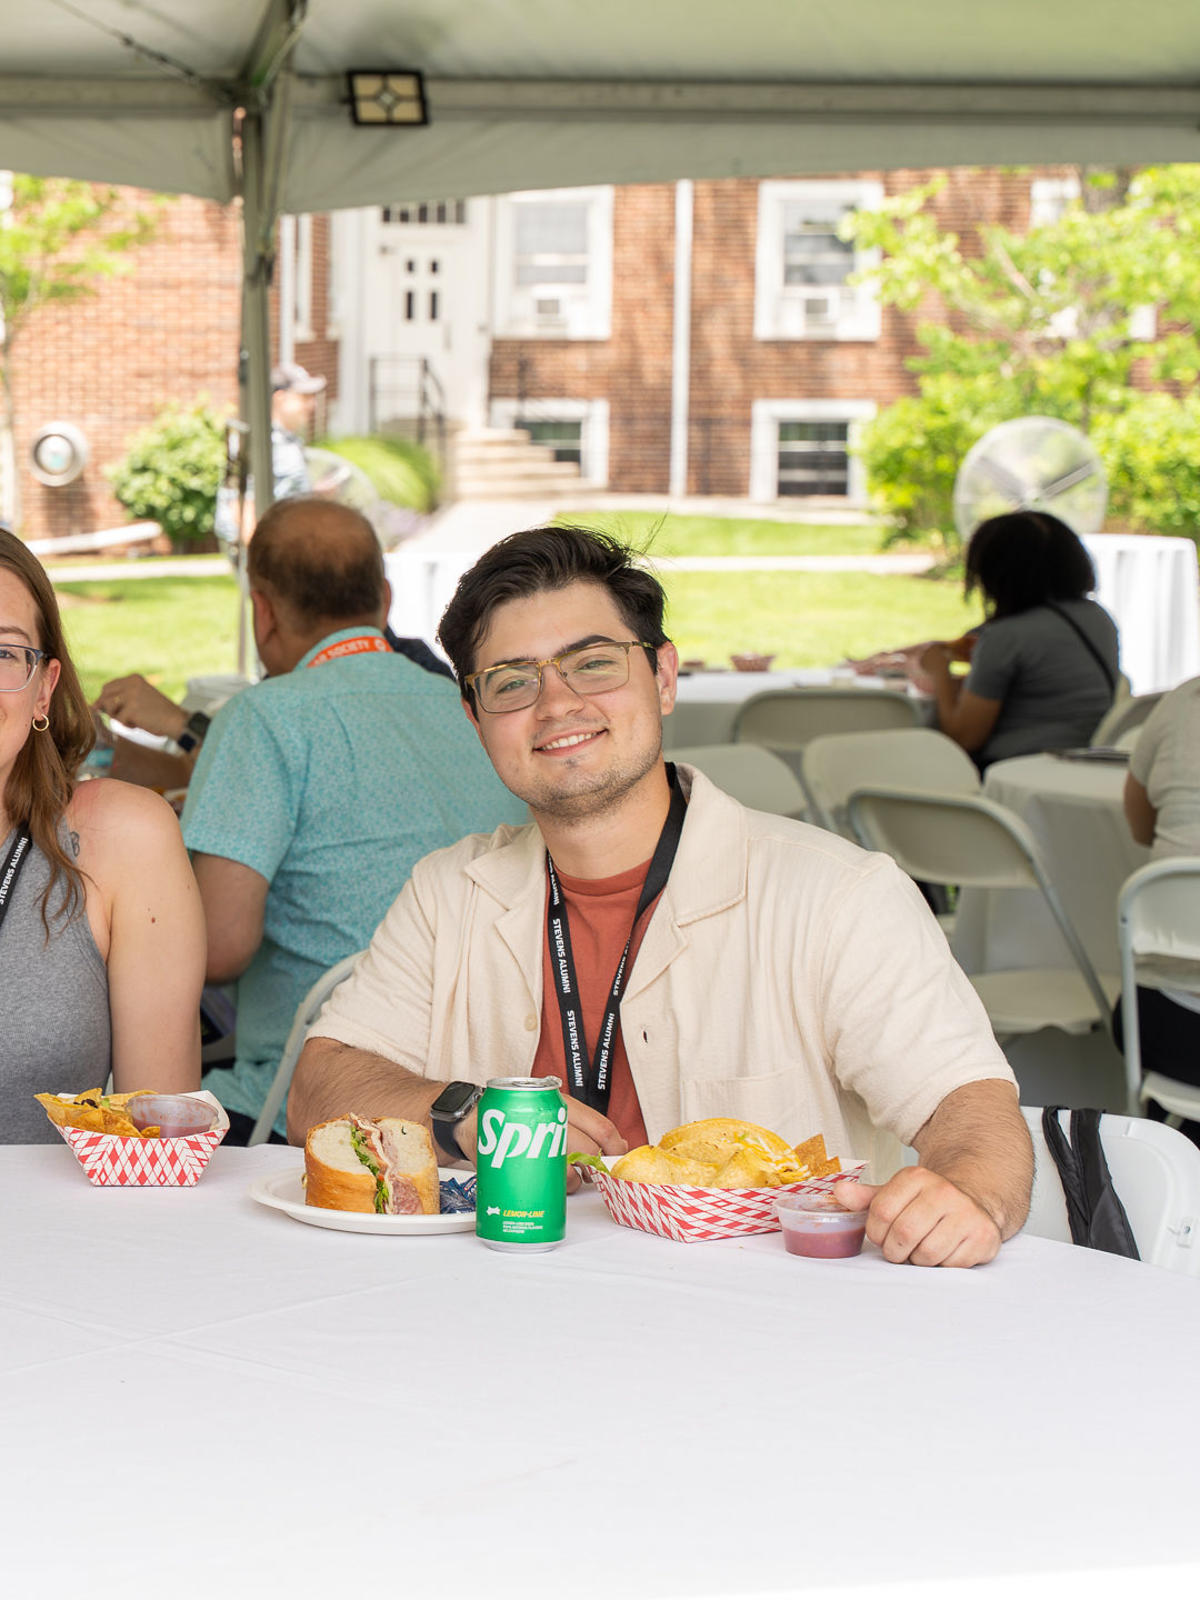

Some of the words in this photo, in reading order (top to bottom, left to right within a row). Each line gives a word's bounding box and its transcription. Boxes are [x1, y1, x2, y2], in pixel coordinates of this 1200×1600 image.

[10, 837, 29, 869] ALUMNI
[553, 918, 566, 958] STEVENS
[557, 958, 571, 994] ALUMNI
[566, 1010, 580, 1051] STEVENS
[572, 1051, 584, 1087] ALUMNI
[597, 1049, 609, 1091] STEVENS
[603, 1013, 615, 1049] ALUMNI
[478, 1107, 567, 1169] Spri
